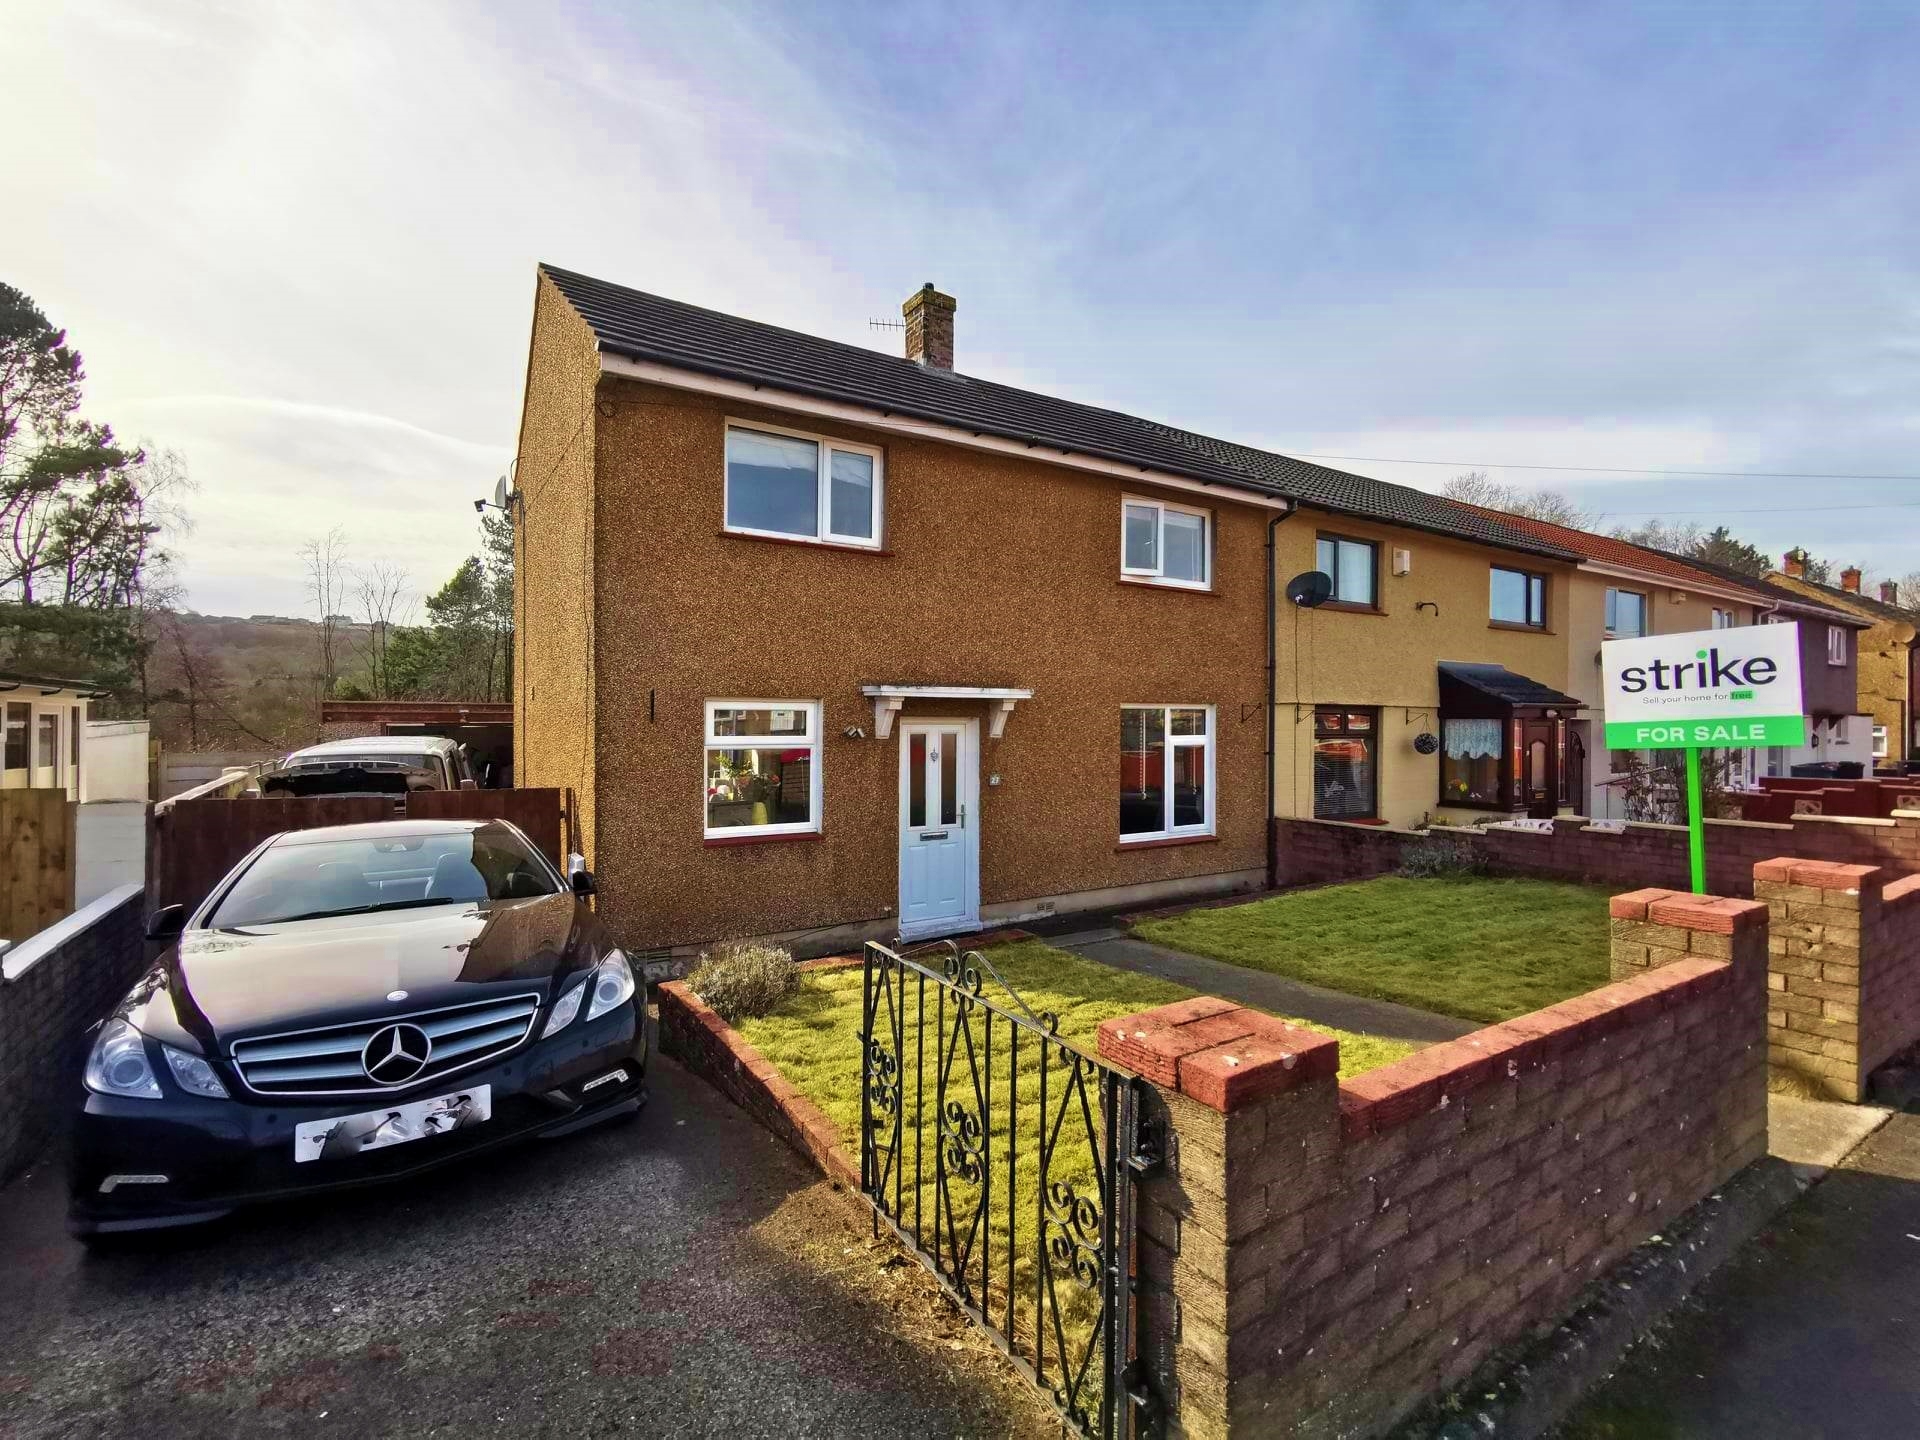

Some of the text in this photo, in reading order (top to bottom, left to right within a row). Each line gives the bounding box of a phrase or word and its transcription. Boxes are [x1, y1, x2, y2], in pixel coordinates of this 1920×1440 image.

[1621, 648, 1777, 693] strike
[1642, 696, 1659, 705] Sell
[1662, 696, 1681, 705] your
[1731, 691, 1753, 700] free
[1636, 724, 1766, 743] FOR SALE
